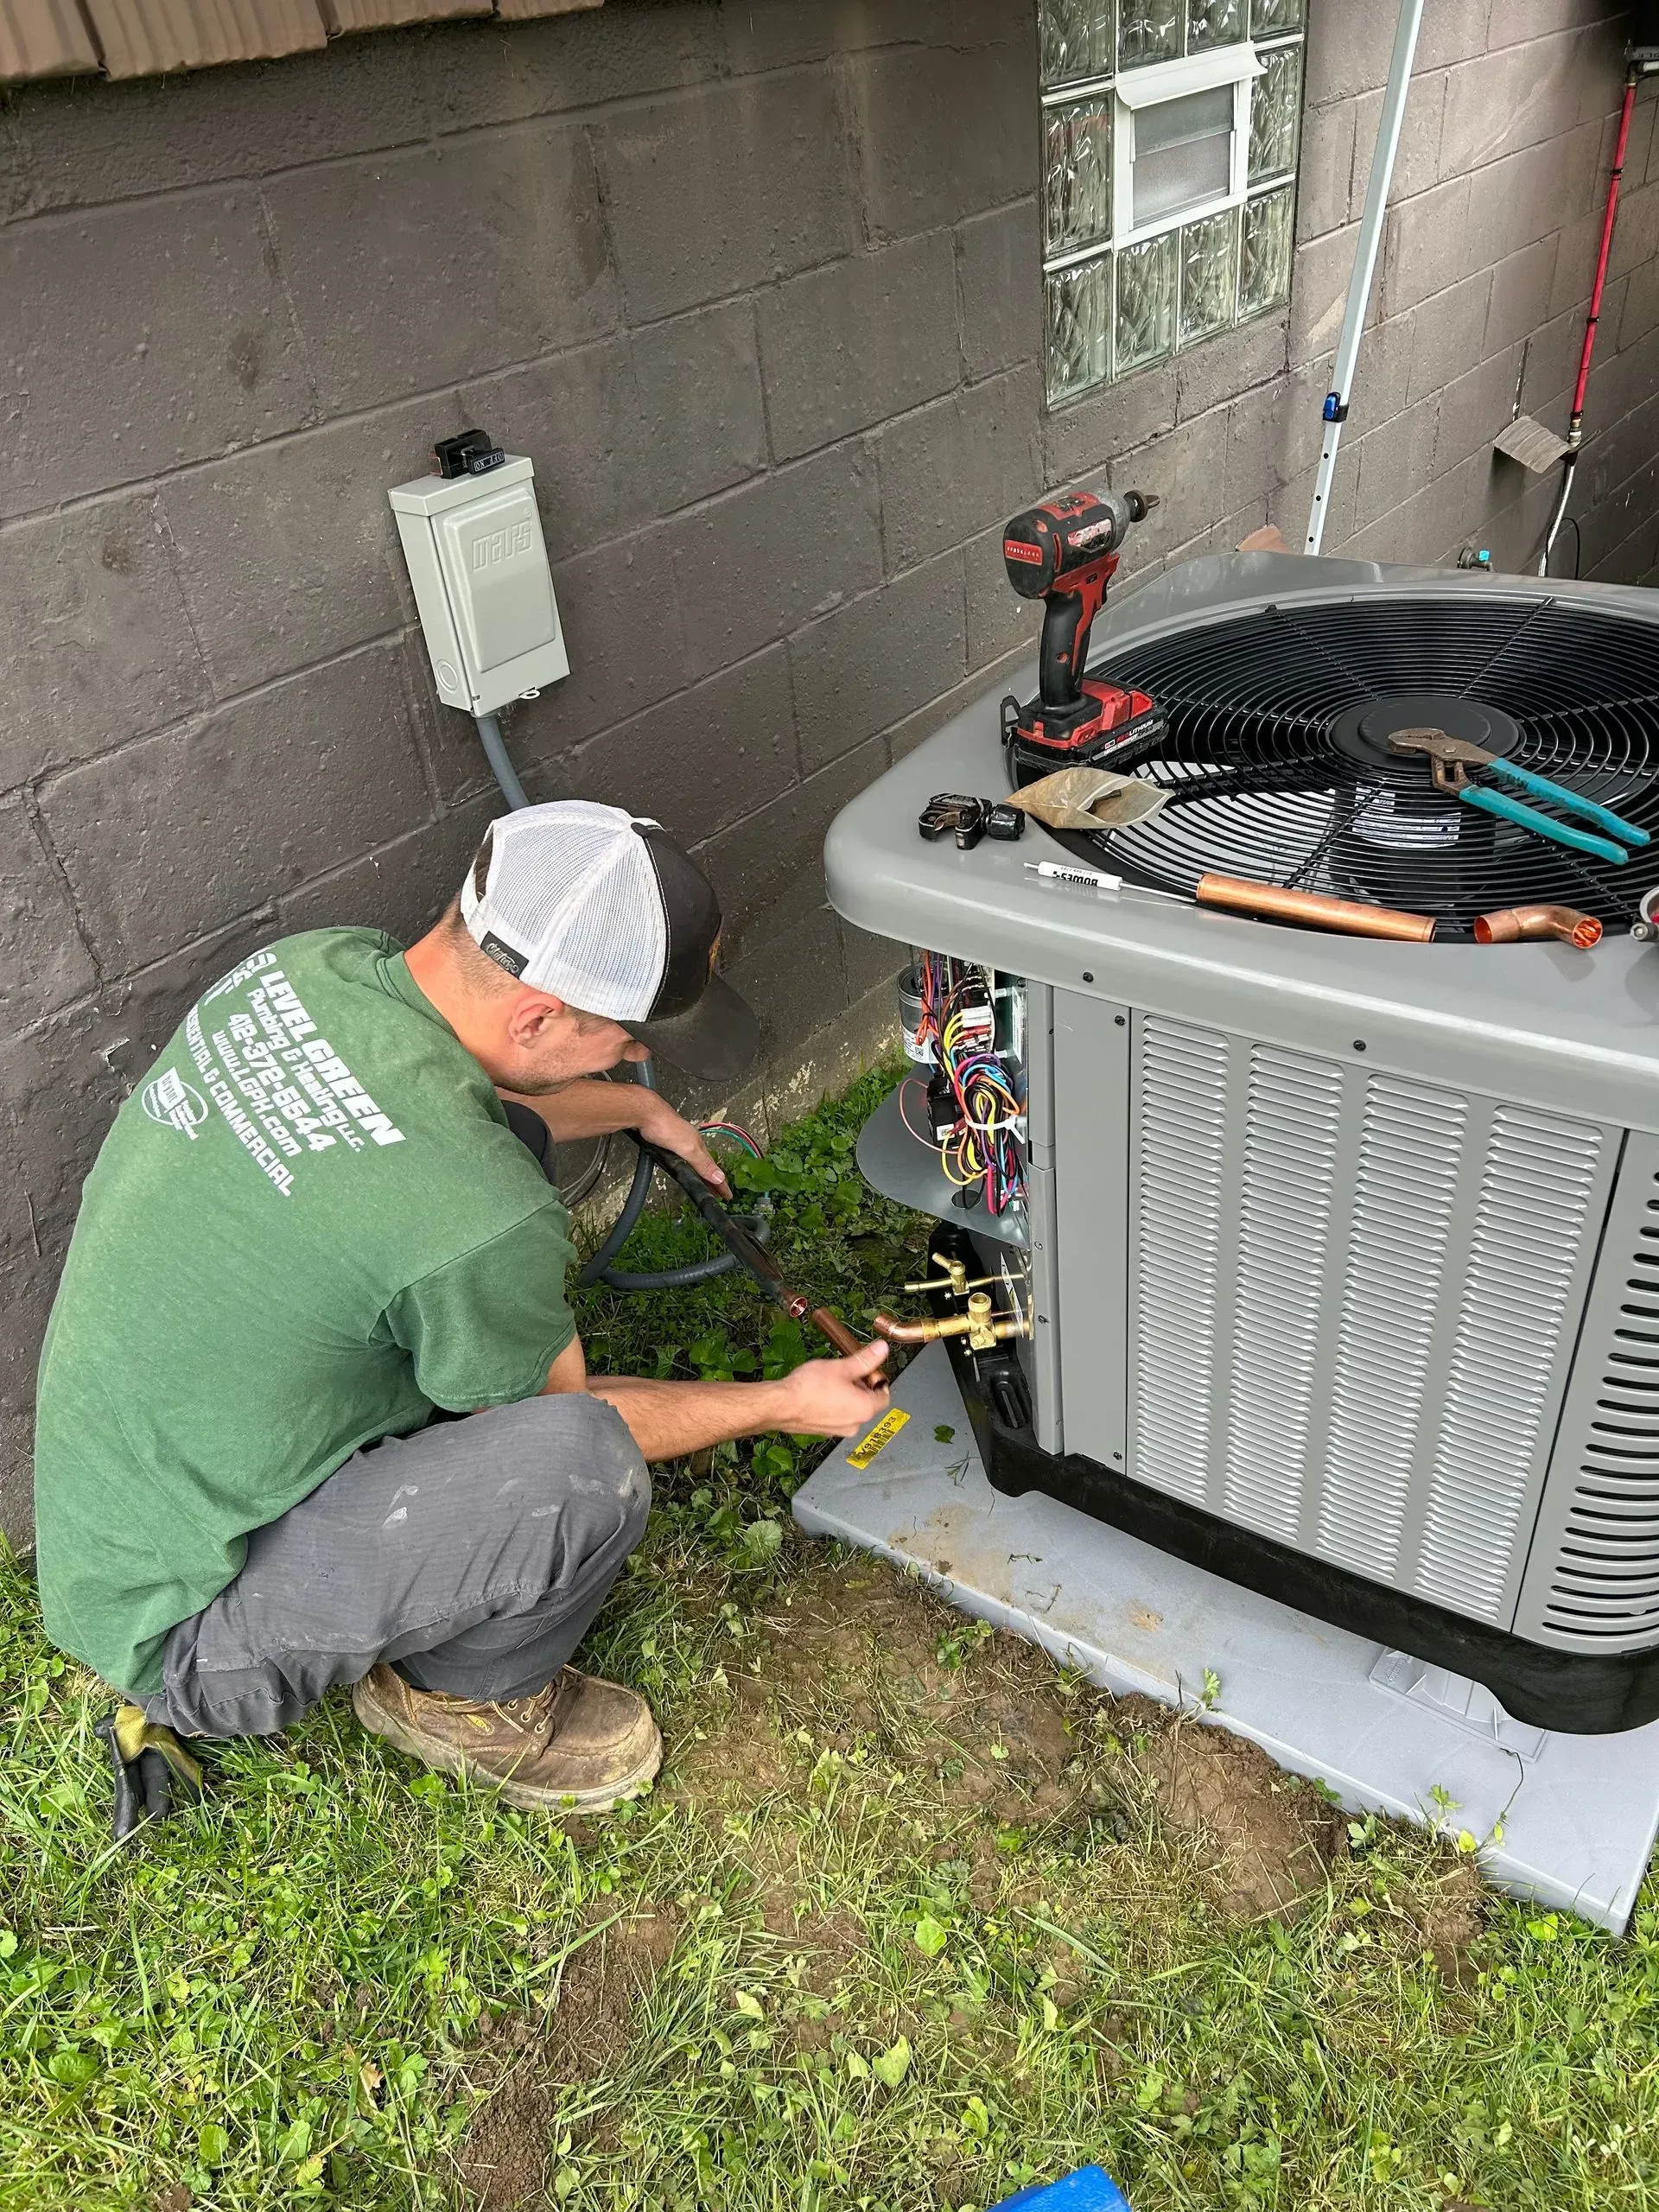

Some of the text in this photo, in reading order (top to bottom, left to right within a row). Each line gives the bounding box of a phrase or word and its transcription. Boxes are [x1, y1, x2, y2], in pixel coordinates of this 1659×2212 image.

[212, 1030, 302, 1157] www.LGPH.com
[247, 988, 291, 1051] Plumbing
[290, 1060, 349, 1127] Heating
[259, 969, 407, 1147] LEVEL GREEN
[209, 1080, 295, 1197] COMMERCIAL
